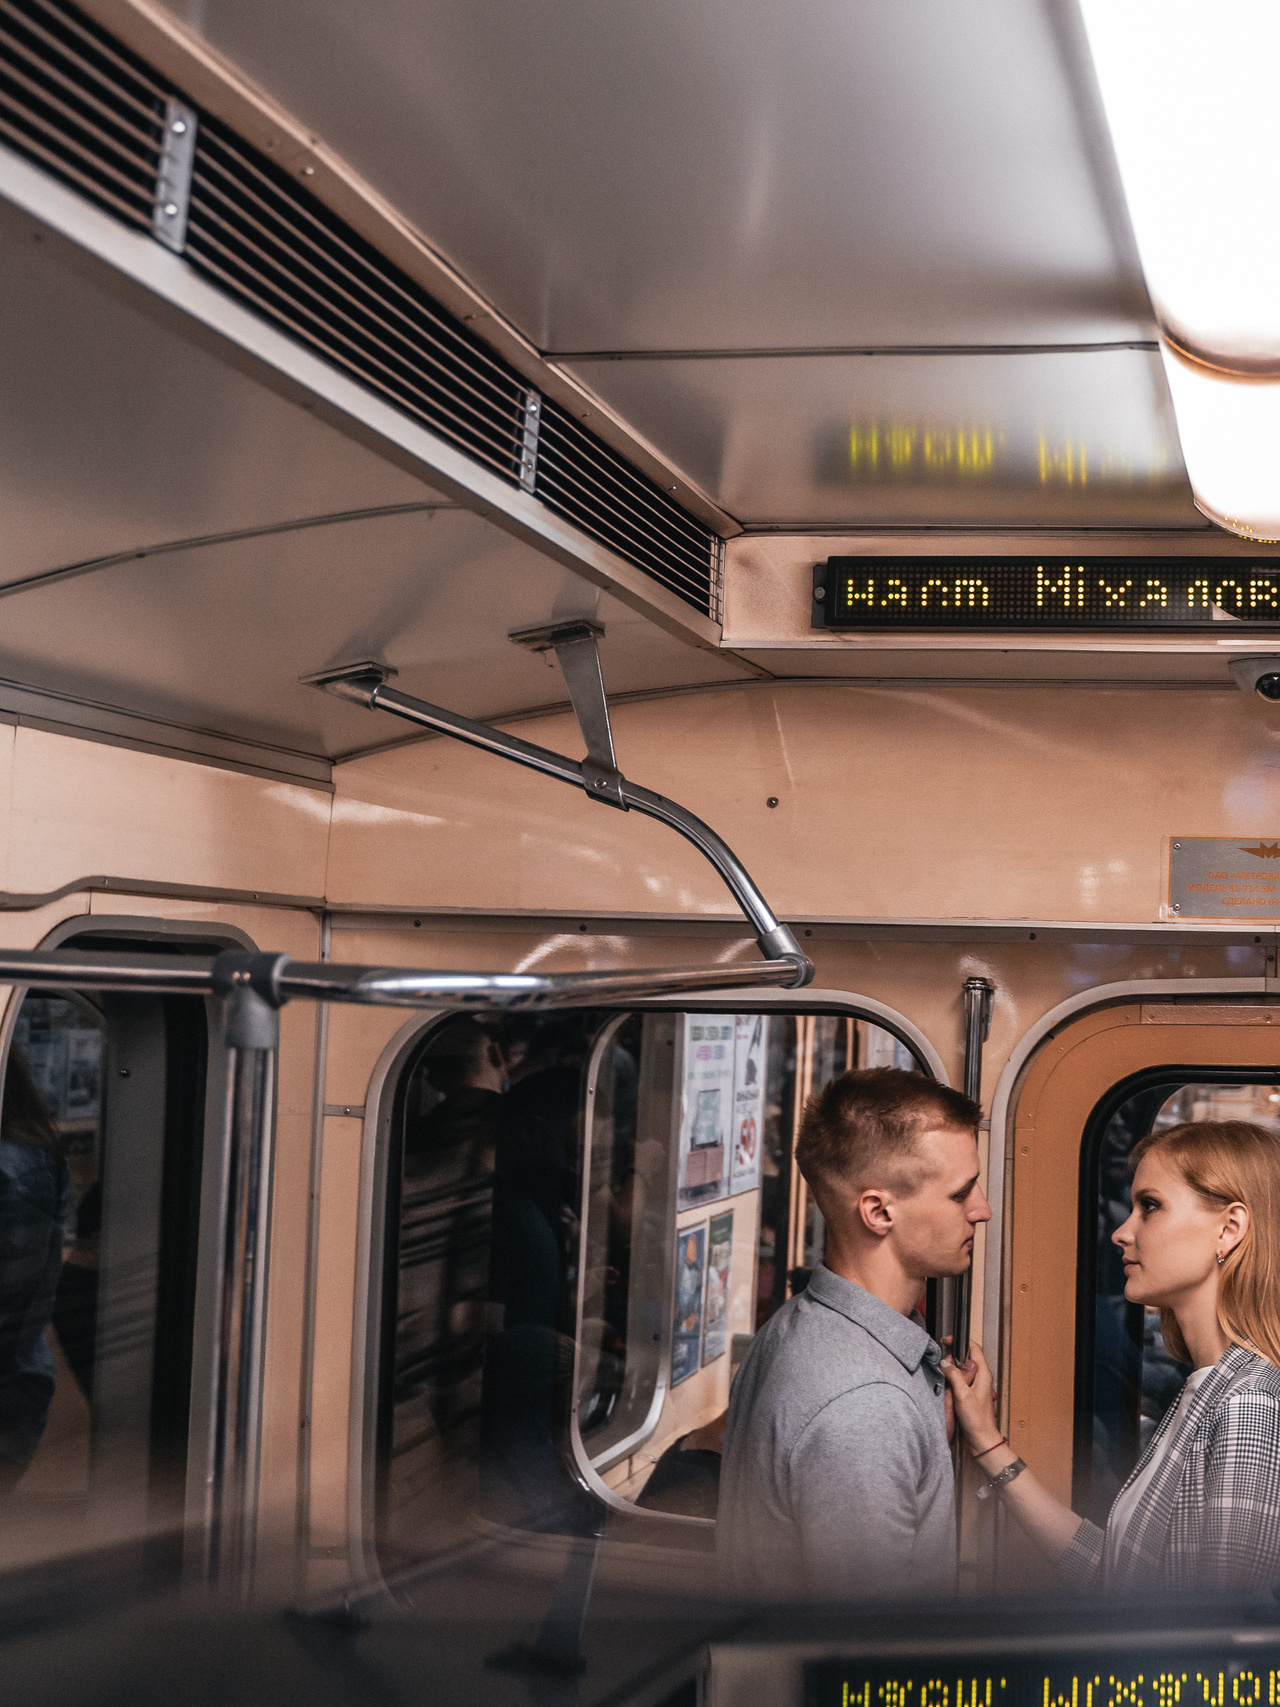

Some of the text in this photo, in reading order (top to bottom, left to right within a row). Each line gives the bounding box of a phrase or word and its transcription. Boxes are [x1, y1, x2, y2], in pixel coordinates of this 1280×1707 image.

[1207, 871, 1228, 879] ОАО
[1186, 883, 1227, 893] МОДЕЛЬ
[1221, 896, 1267, 907] СДЕЛАНО
[1268, 898, 1275, 906] В
